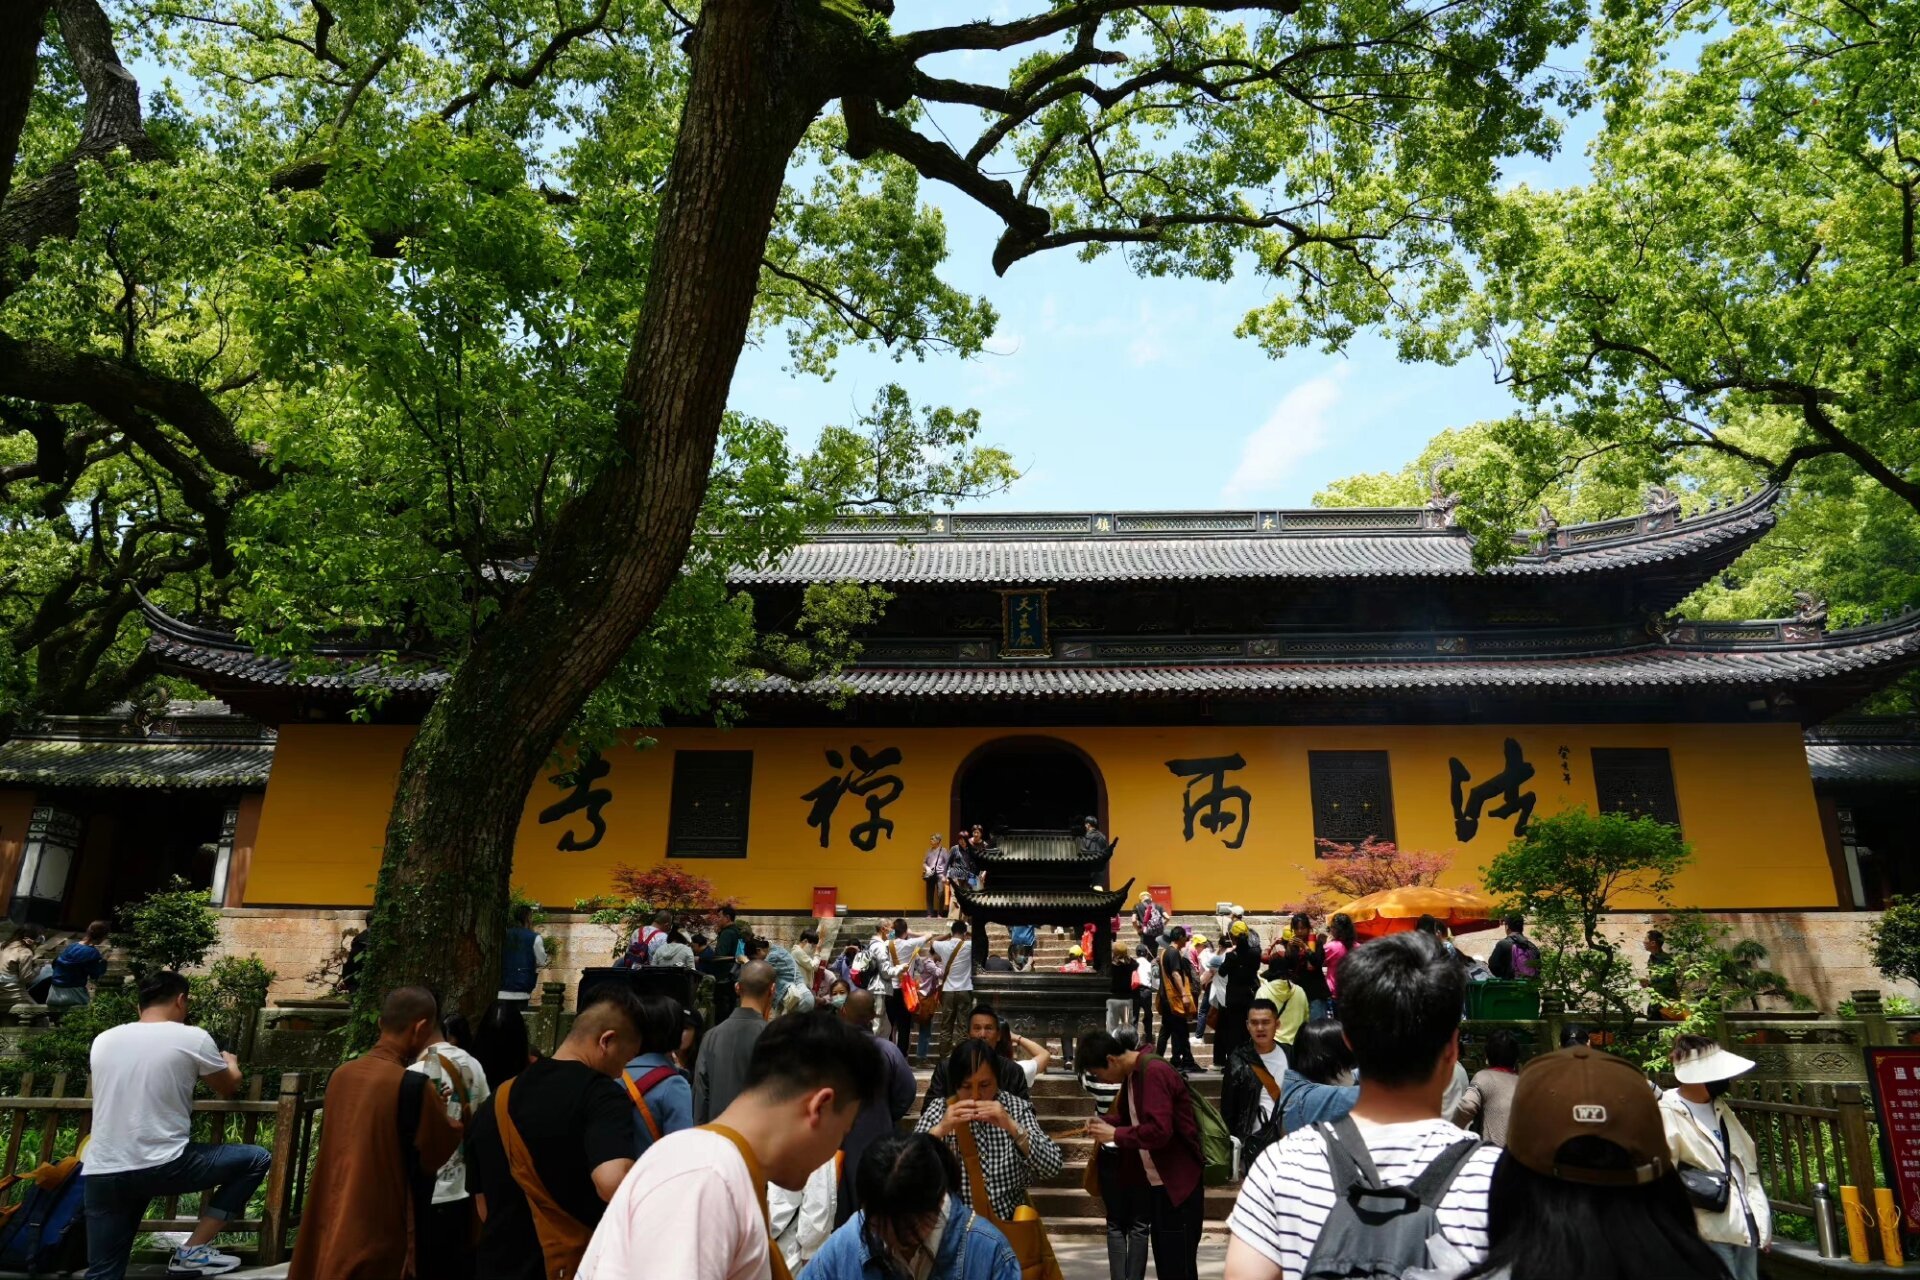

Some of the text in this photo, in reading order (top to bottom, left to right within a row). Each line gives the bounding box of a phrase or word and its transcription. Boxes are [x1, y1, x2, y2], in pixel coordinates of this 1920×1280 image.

[538, 741, 612, 852] 寺
[1164, 753, 1252, 849] 雨
[1448, 737, 1536, 843] 法
[1577, 1107, 1601, 1119] WY
